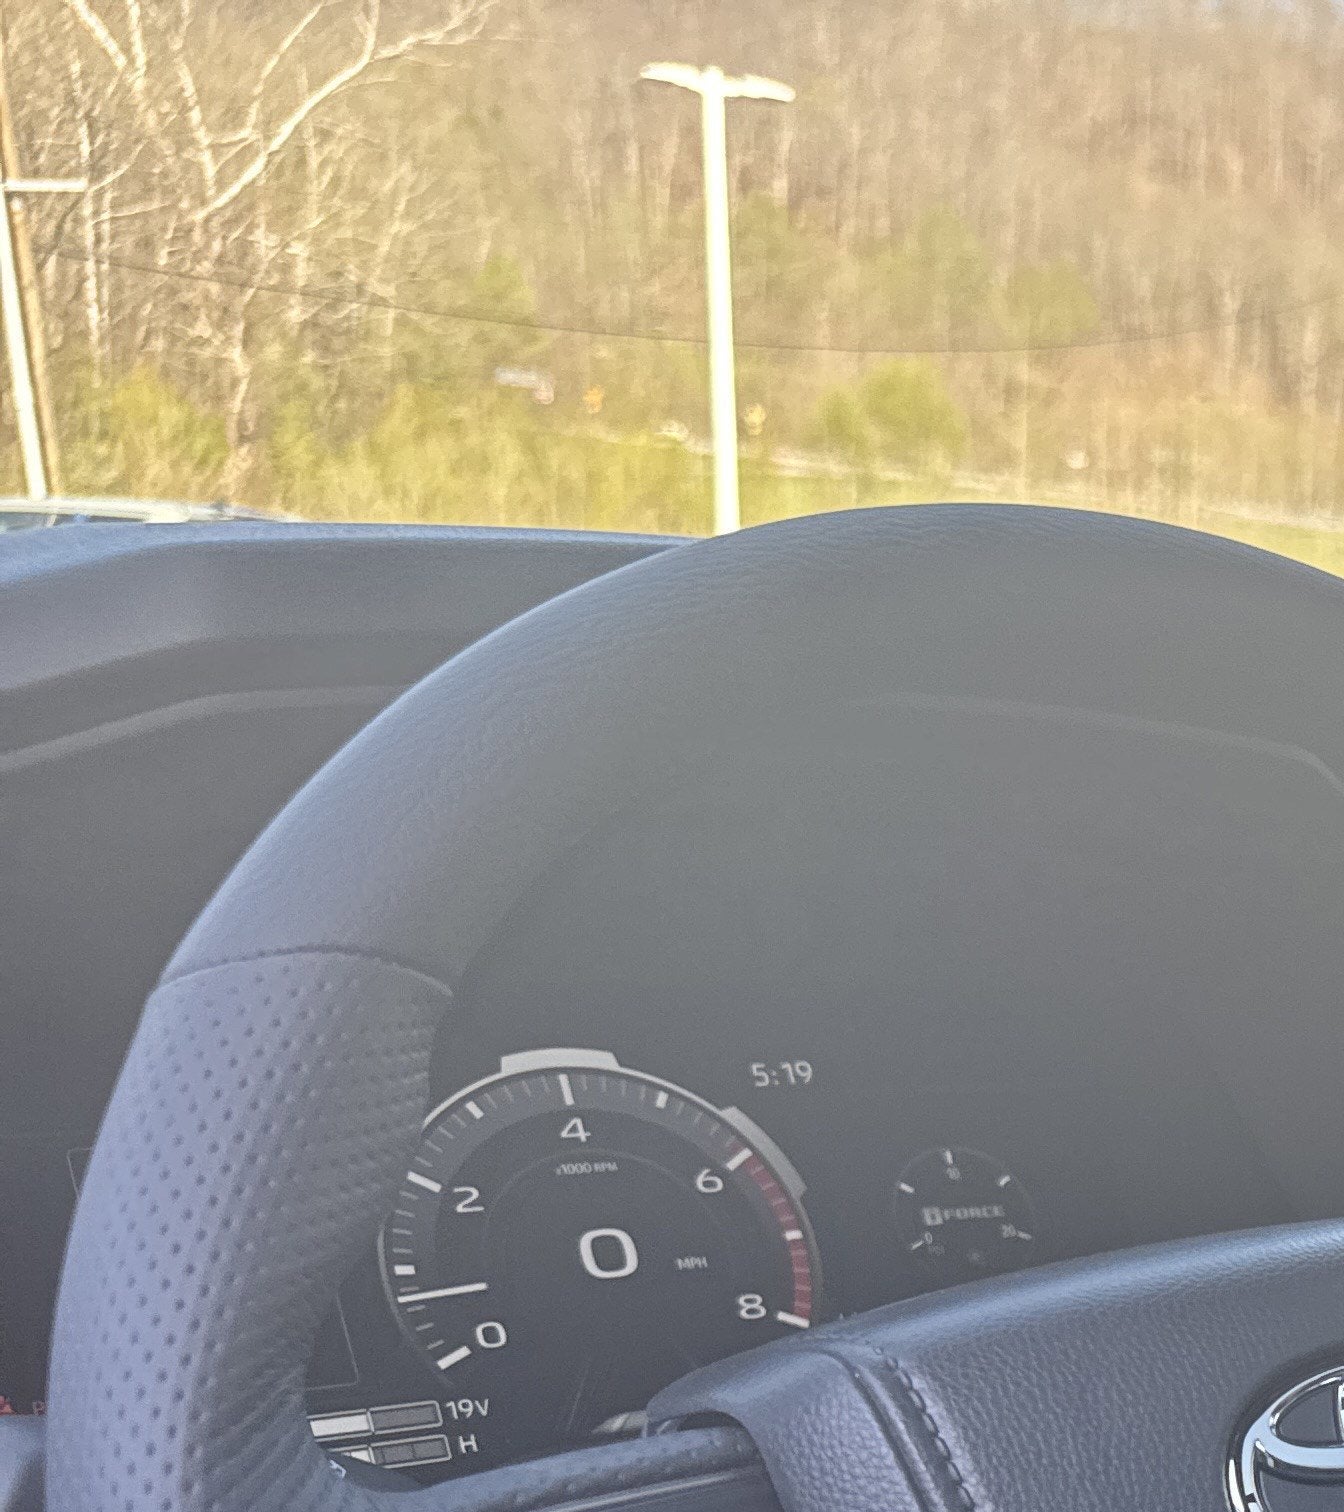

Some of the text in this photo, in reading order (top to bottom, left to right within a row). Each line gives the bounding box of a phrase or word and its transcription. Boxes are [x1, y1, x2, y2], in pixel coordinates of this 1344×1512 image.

[751, 1060, 813, 1088] 5:19
[560, 1117, 592, 1143] 4
[695, 1168, 724, 1194] 6
[452, 1186, 485, 1213] 2
[578, 1228, 640, 1279] 0
[675, 1255, 709, 1271] MPH
[738, 1293, 766, 1321] 8
[475, 1321, 508, 1349] 0
[445, 1397, 491, 1421] 19V
[459, 1432, 479, 1454] H
